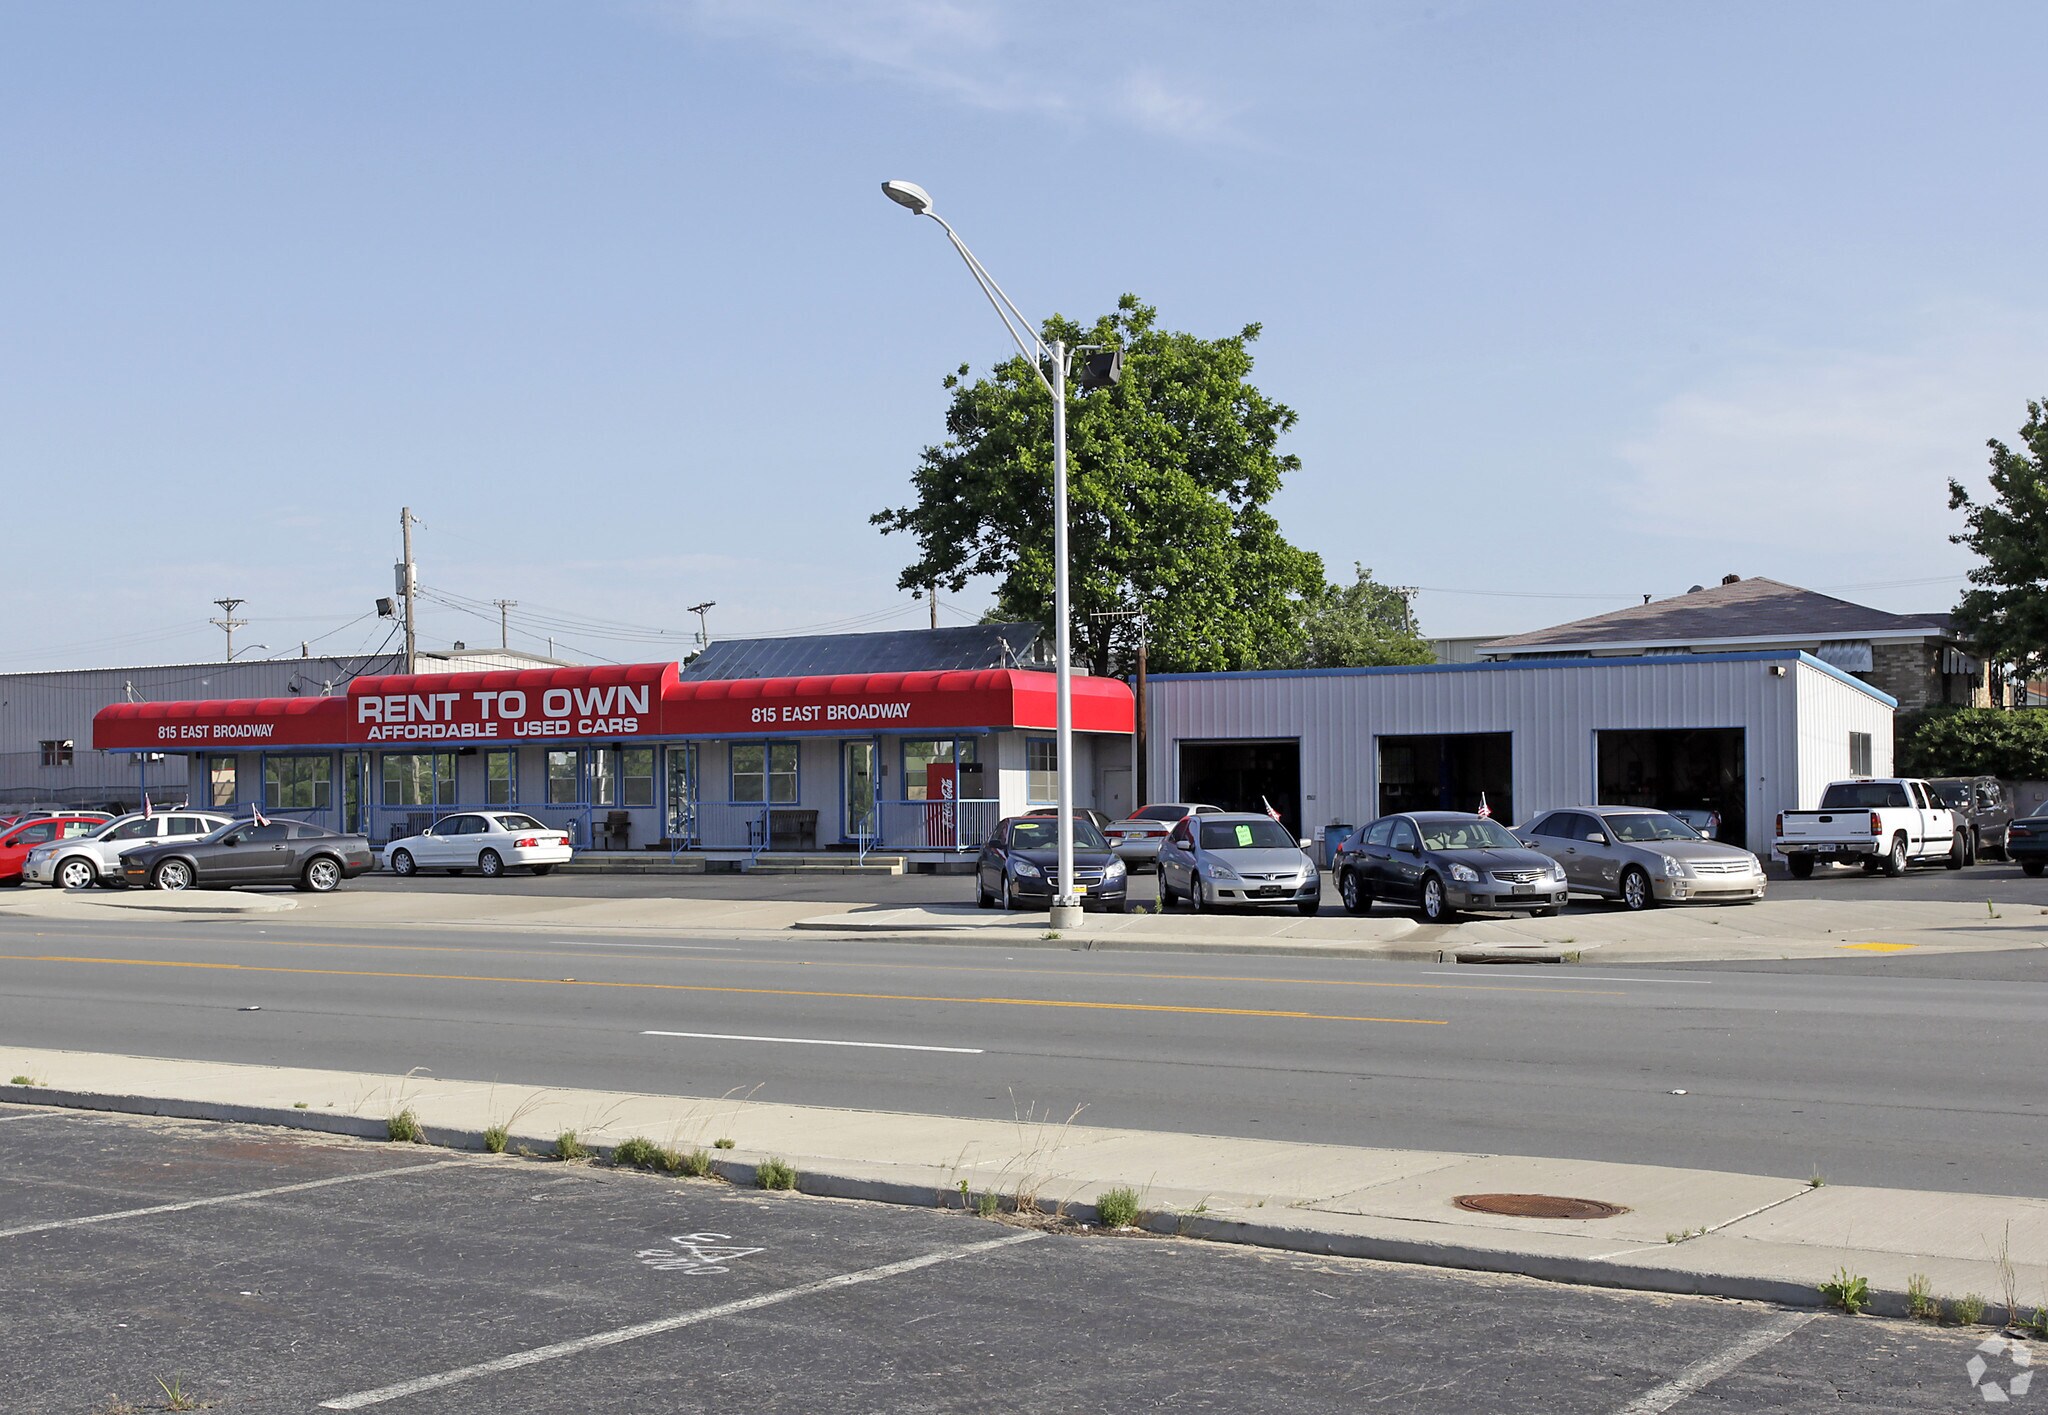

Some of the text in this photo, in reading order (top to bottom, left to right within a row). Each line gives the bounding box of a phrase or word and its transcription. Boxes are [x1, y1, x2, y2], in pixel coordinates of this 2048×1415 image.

[358, 685, 649, 723] RENT TO OWN
[751, 703, 911, 722] 815 EAST BROADWAY
[158, 724, 274, 739] 815 EAST BROADWAY
[367, 717, 638, 740] AFFORDABLE USED CARS
